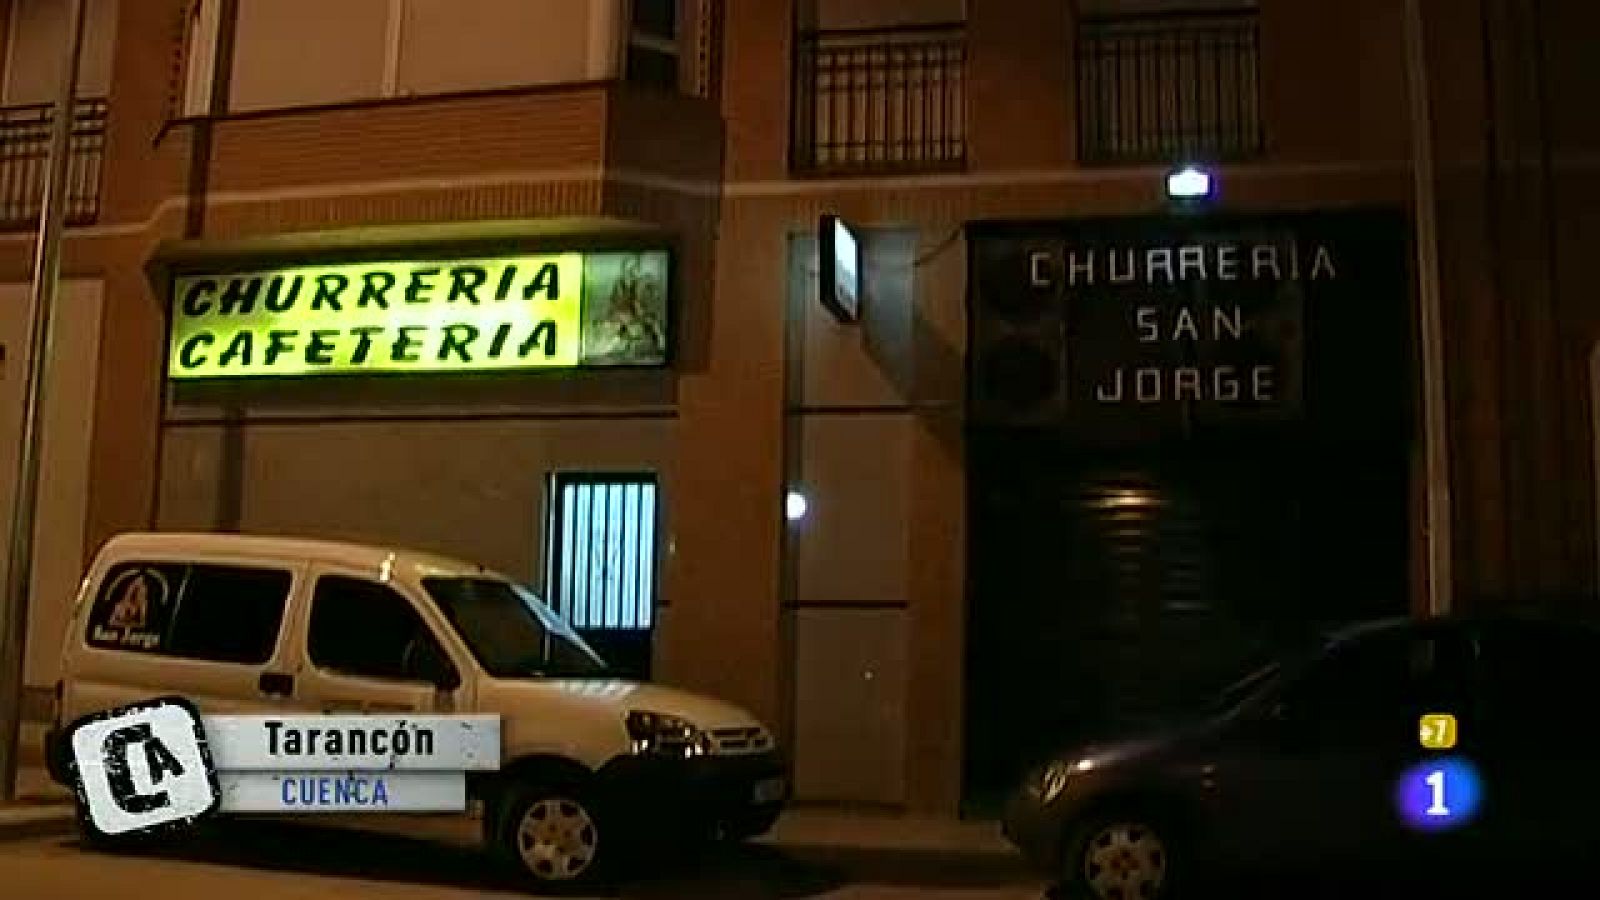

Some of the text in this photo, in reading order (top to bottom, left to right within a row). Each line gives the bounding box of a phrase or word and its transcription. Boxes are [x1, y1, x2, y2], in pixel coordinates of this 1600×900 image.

[181, 262, 560, 317] CHURRERIA
[179, 319, 558, 368] CAFETERIA
[1136, 305, 1242, 342] SAN
[1097, 364, 1276, 401] JORGE
